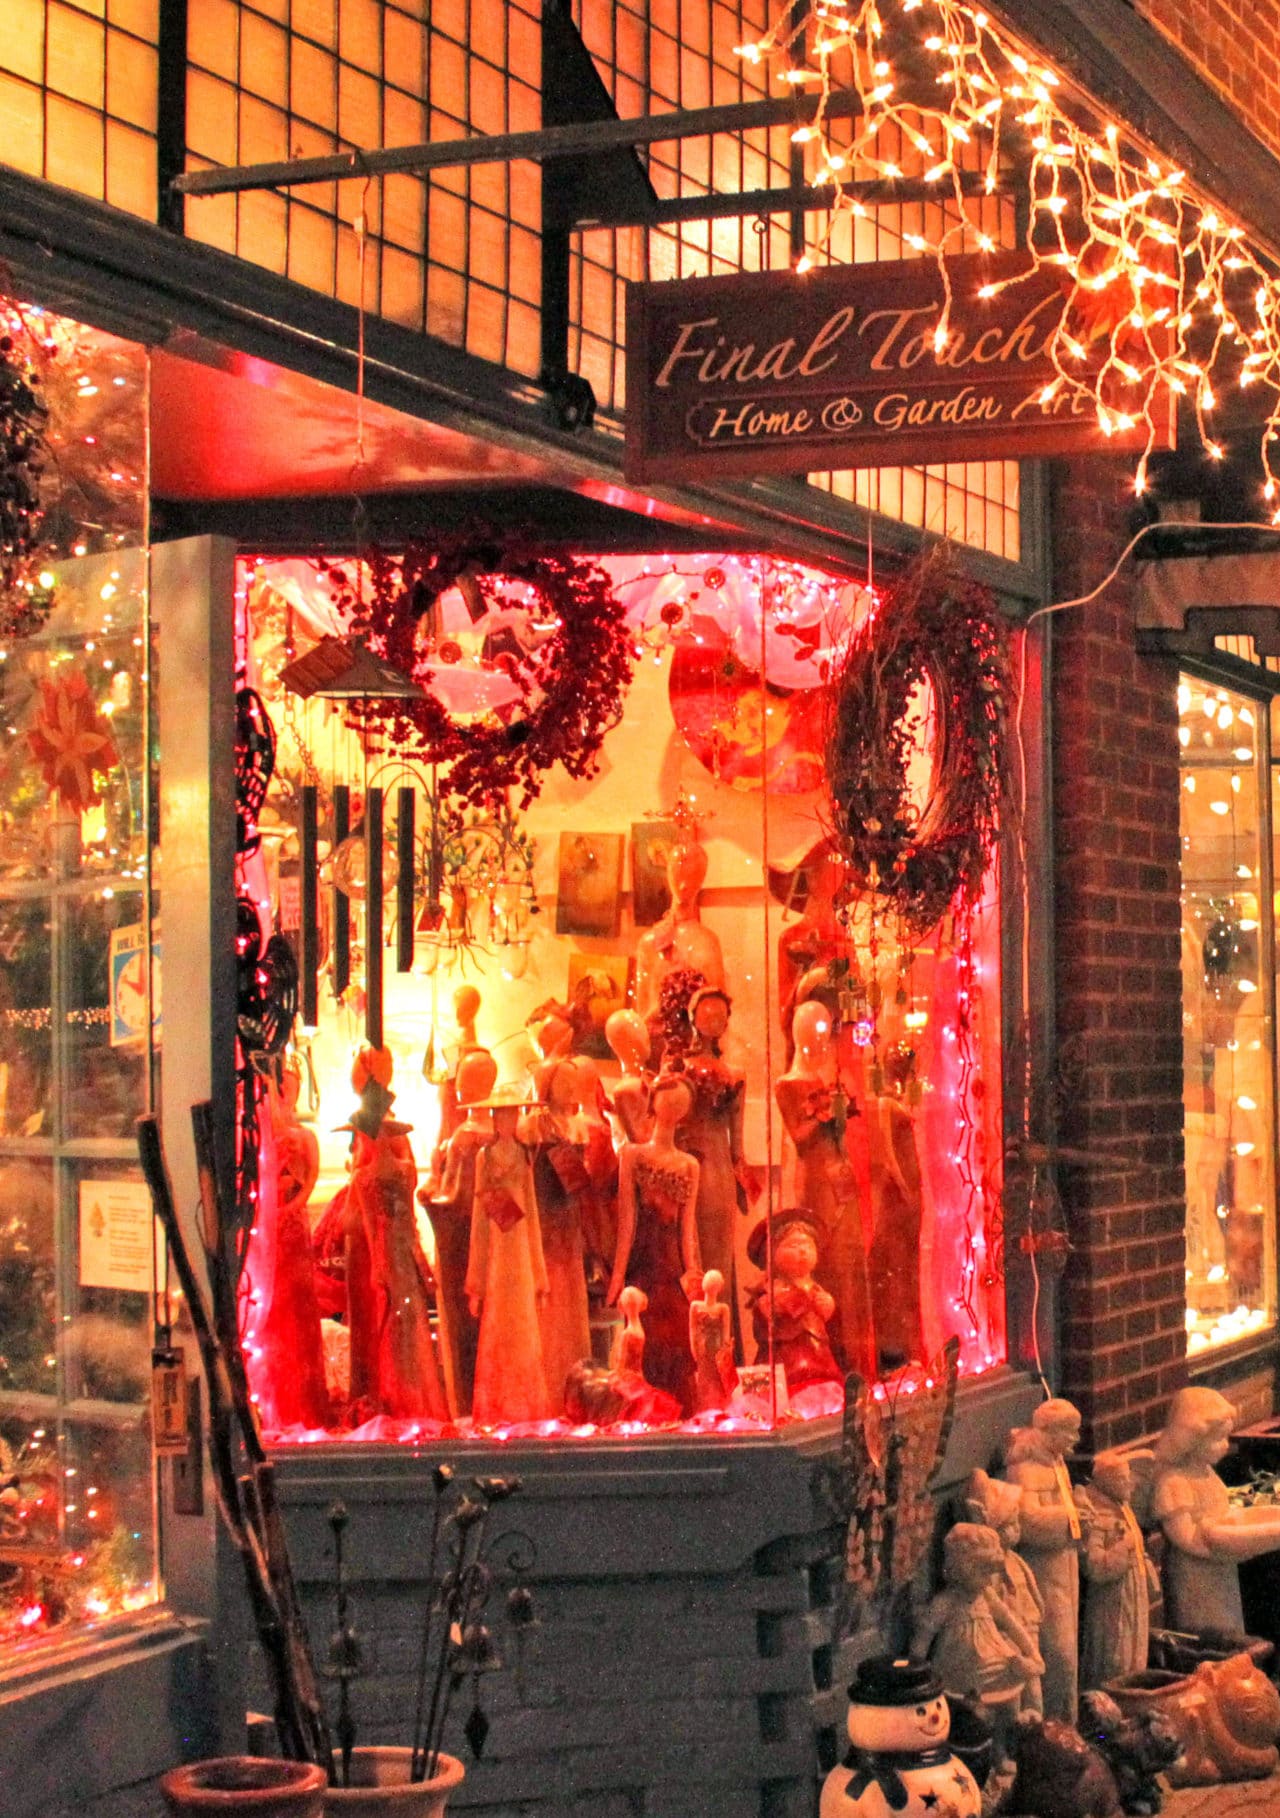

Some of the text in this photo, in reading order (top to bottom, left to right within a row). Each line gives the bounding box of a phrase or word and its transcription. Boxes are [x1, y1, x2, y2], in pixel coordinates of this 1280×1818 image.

[655, 290, 1070, 386] Final Touch
[709, 379, 1087, 438] Home & Garden Art
